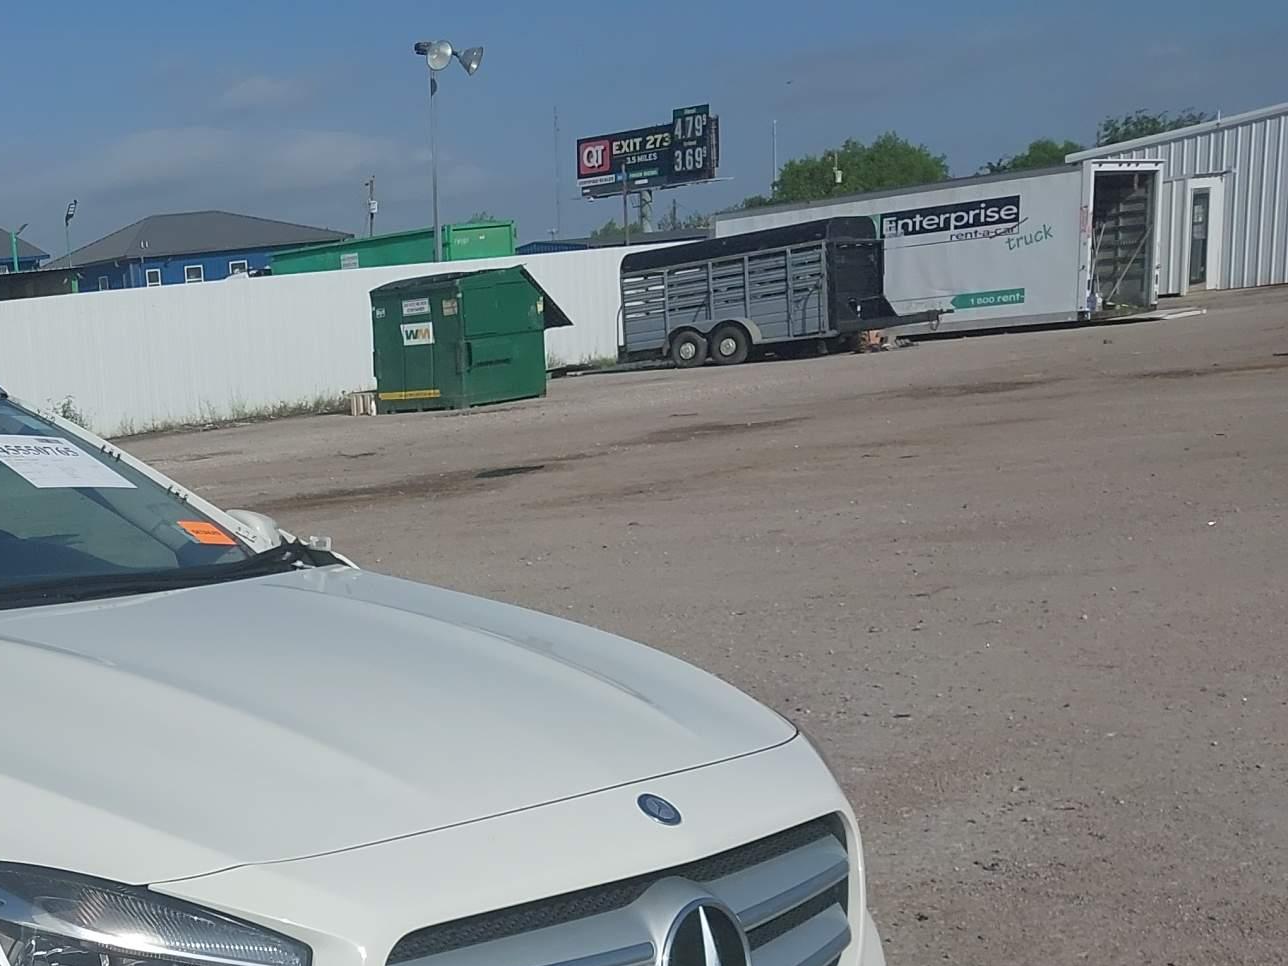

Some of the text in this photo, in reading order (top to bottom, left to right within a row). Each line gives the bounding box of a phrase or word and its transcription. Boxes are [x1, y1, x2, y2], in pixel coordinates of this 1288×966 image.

[612, 132, 672, 155] EXIT 273
[583, 146, 605, 168] QT
[637, 152, 658, 163] MILES
[882, 202, 1018, 235] Enterprise
[1005, 223, 1053, 251] truck
[404, 328, 430, 341] WM
